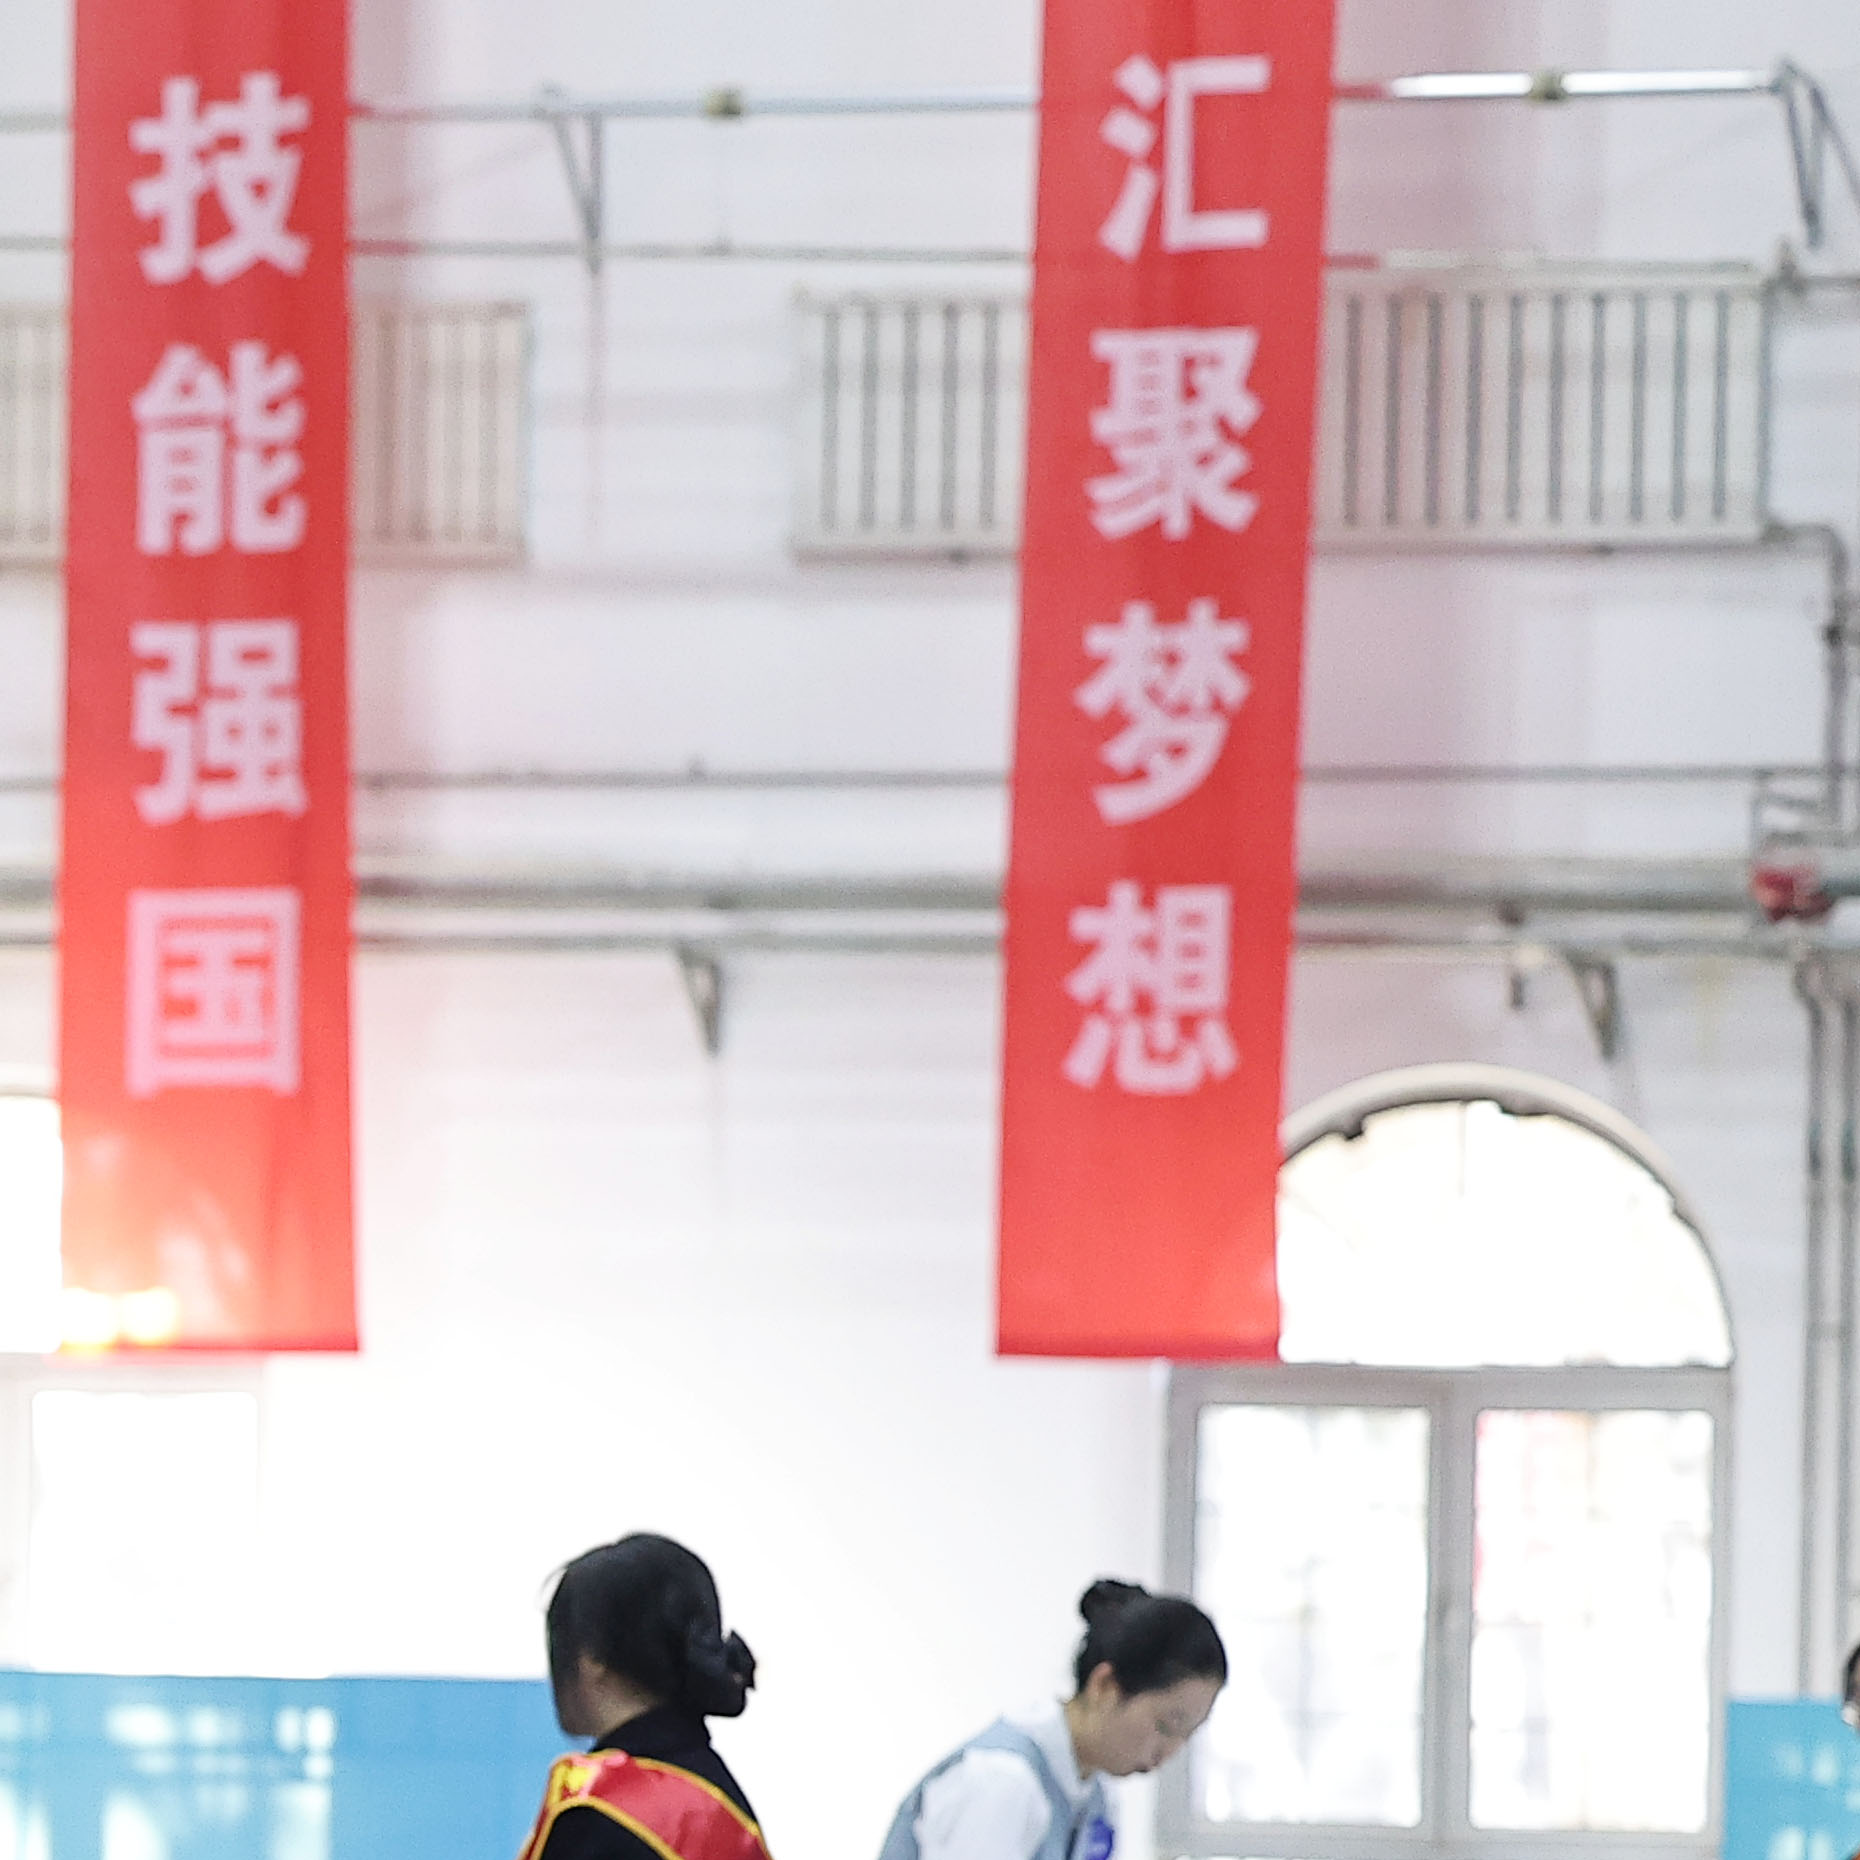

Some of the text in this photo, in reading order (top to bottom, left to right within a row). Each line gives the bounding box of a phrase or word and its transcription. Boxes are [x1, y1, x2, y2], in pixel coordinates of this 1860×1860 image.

[125, 70, 311, 1100] 技能强国
[1063, 53, 1272, 1095] 汇聚梦想
